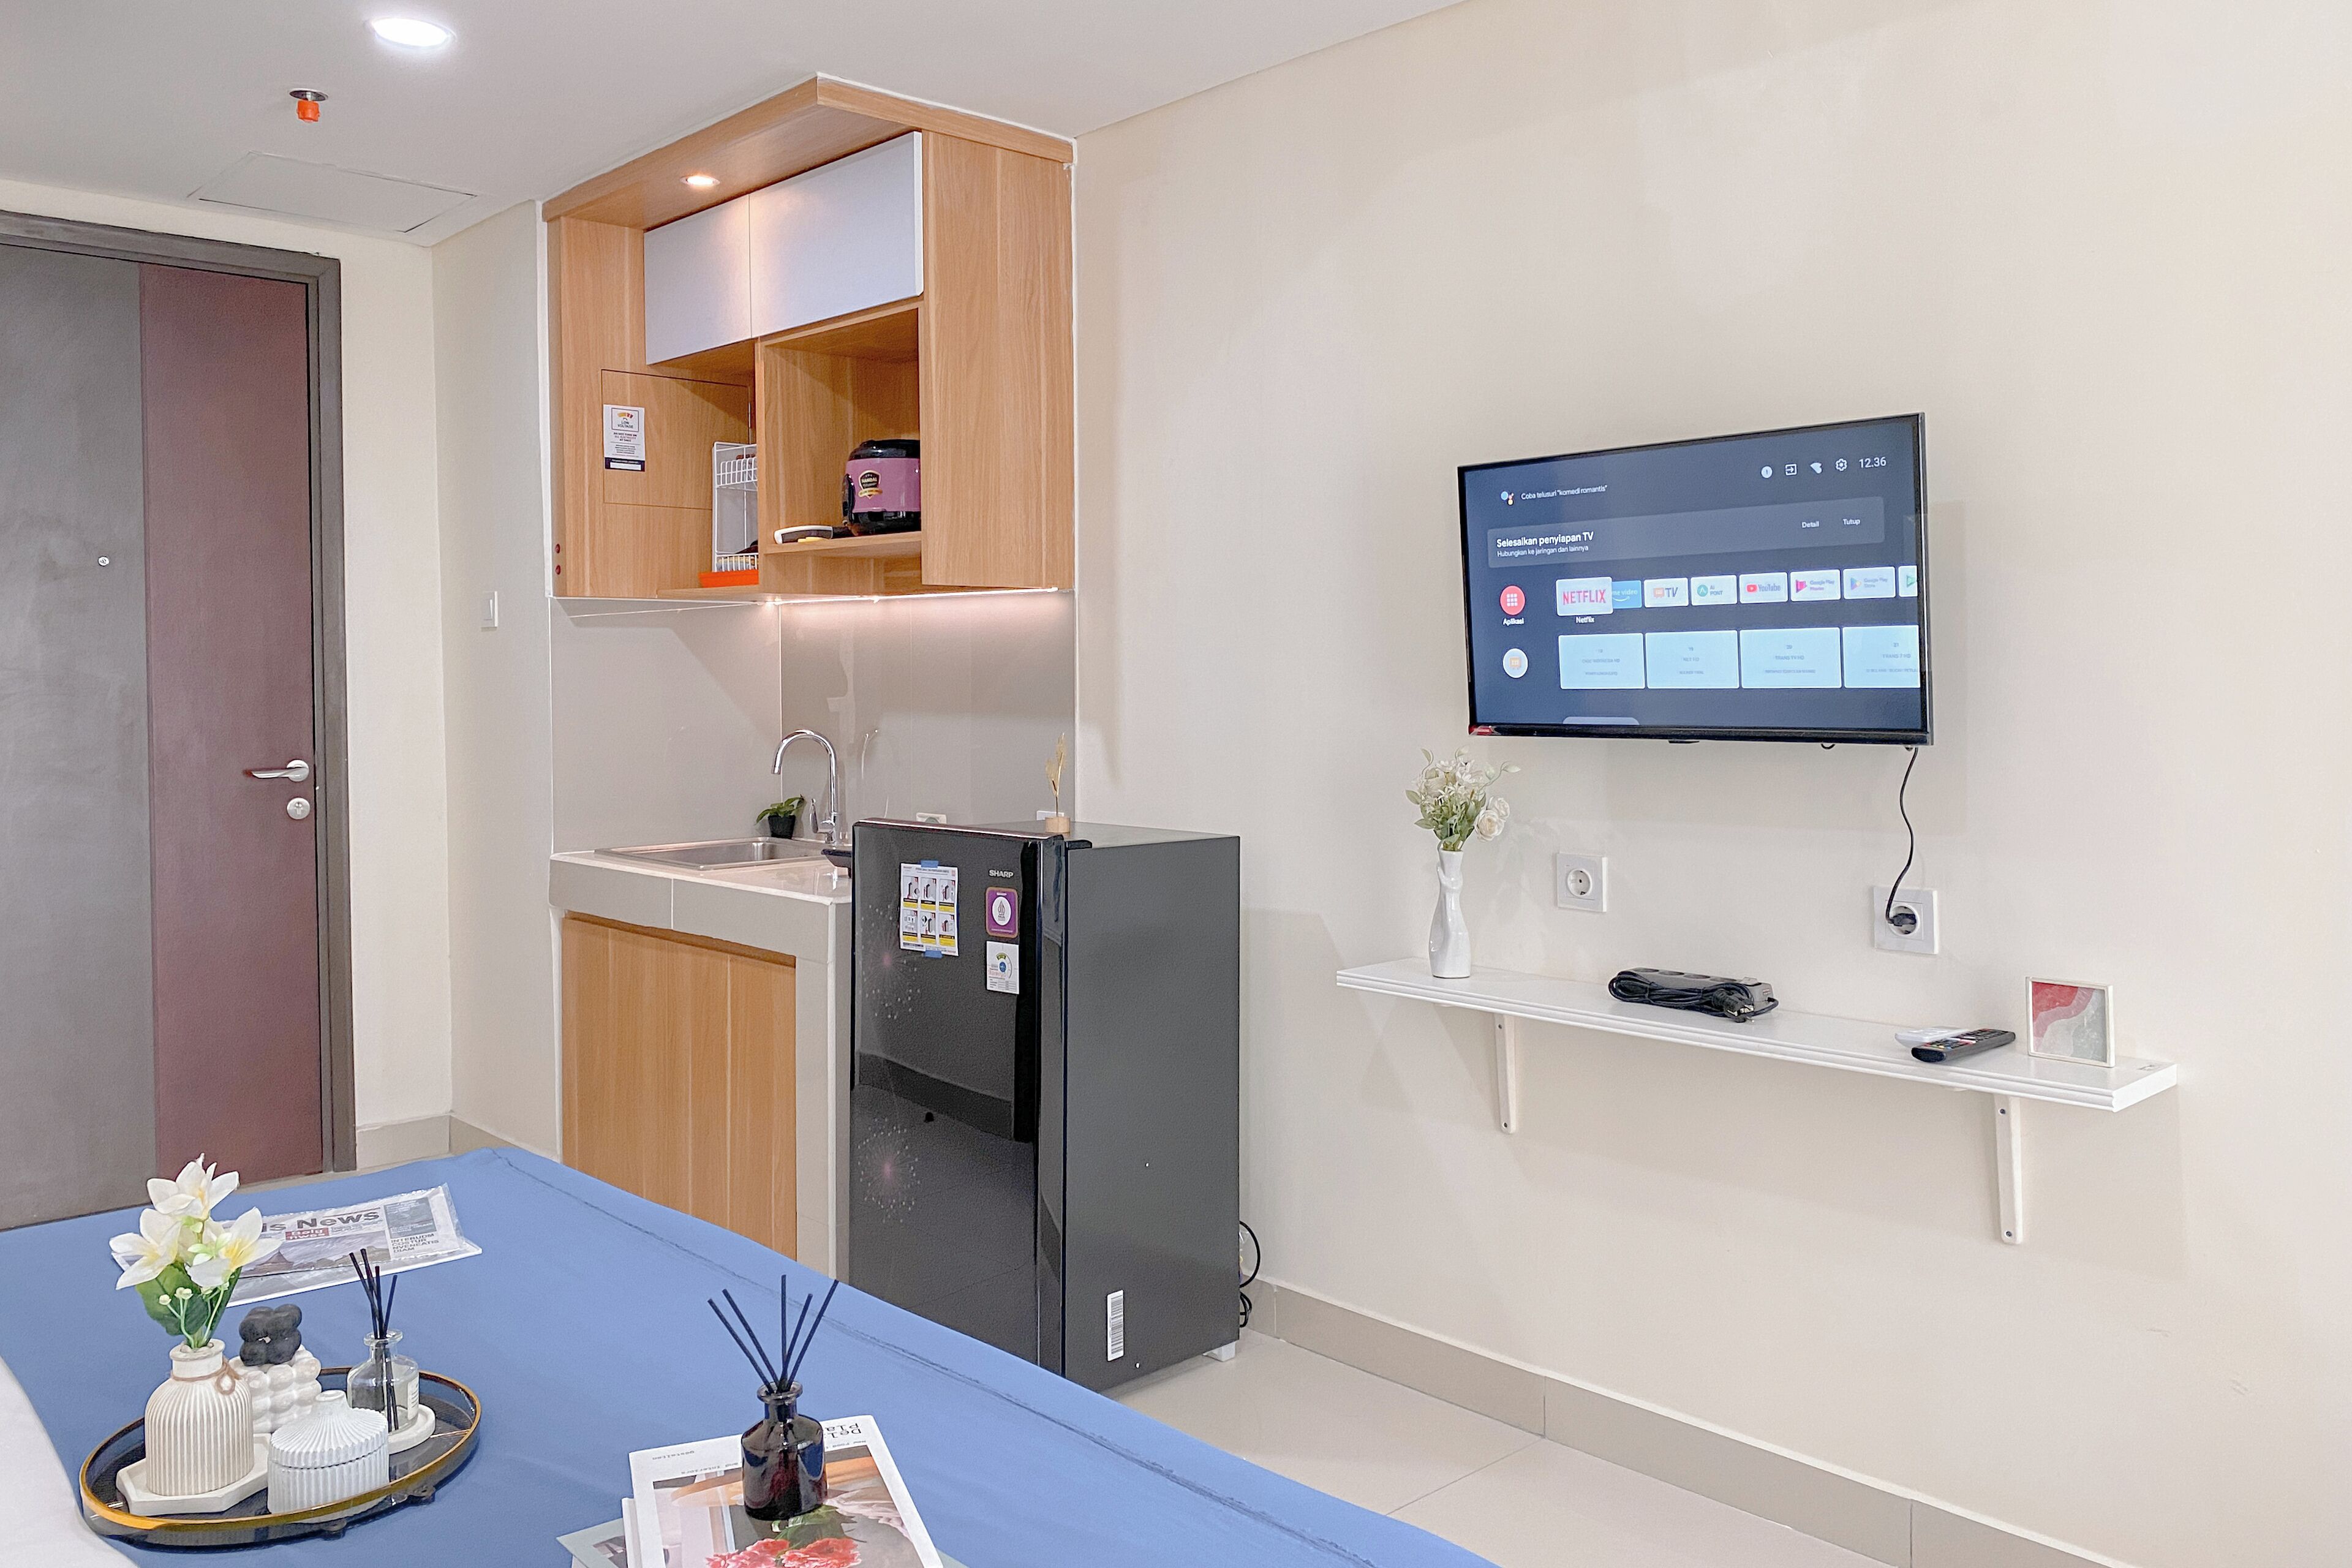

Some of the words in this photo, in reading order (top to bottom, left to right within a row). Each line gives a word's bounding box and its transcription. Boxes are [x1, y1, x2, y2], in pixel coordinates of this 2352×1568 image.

[1858, 456, 1887, 469] 12.36
[1536, 489, 1557, 498] telusuri
[1496, 537, 1538, 548] Selesaikan
[1539, 533, 1581, 546] penyiapan
[1582, 531, 1594, 541] TV
[1497, 549, 1528, 557] Hubungkan
[1535, 547, 1557, 556] jaringan
[1665, 587, 1678, 597] TV
[1758, 584, 1781, 592] YouTube
[1562, 589, 1607, 606] NETFLIX
[1502, 617, 1525, 626] Aplikasi
[989, 869, 1014, 878] SHARP
[297, 1212, 380, 1229] News
[652, 1450, 695, 1461] gestalten
